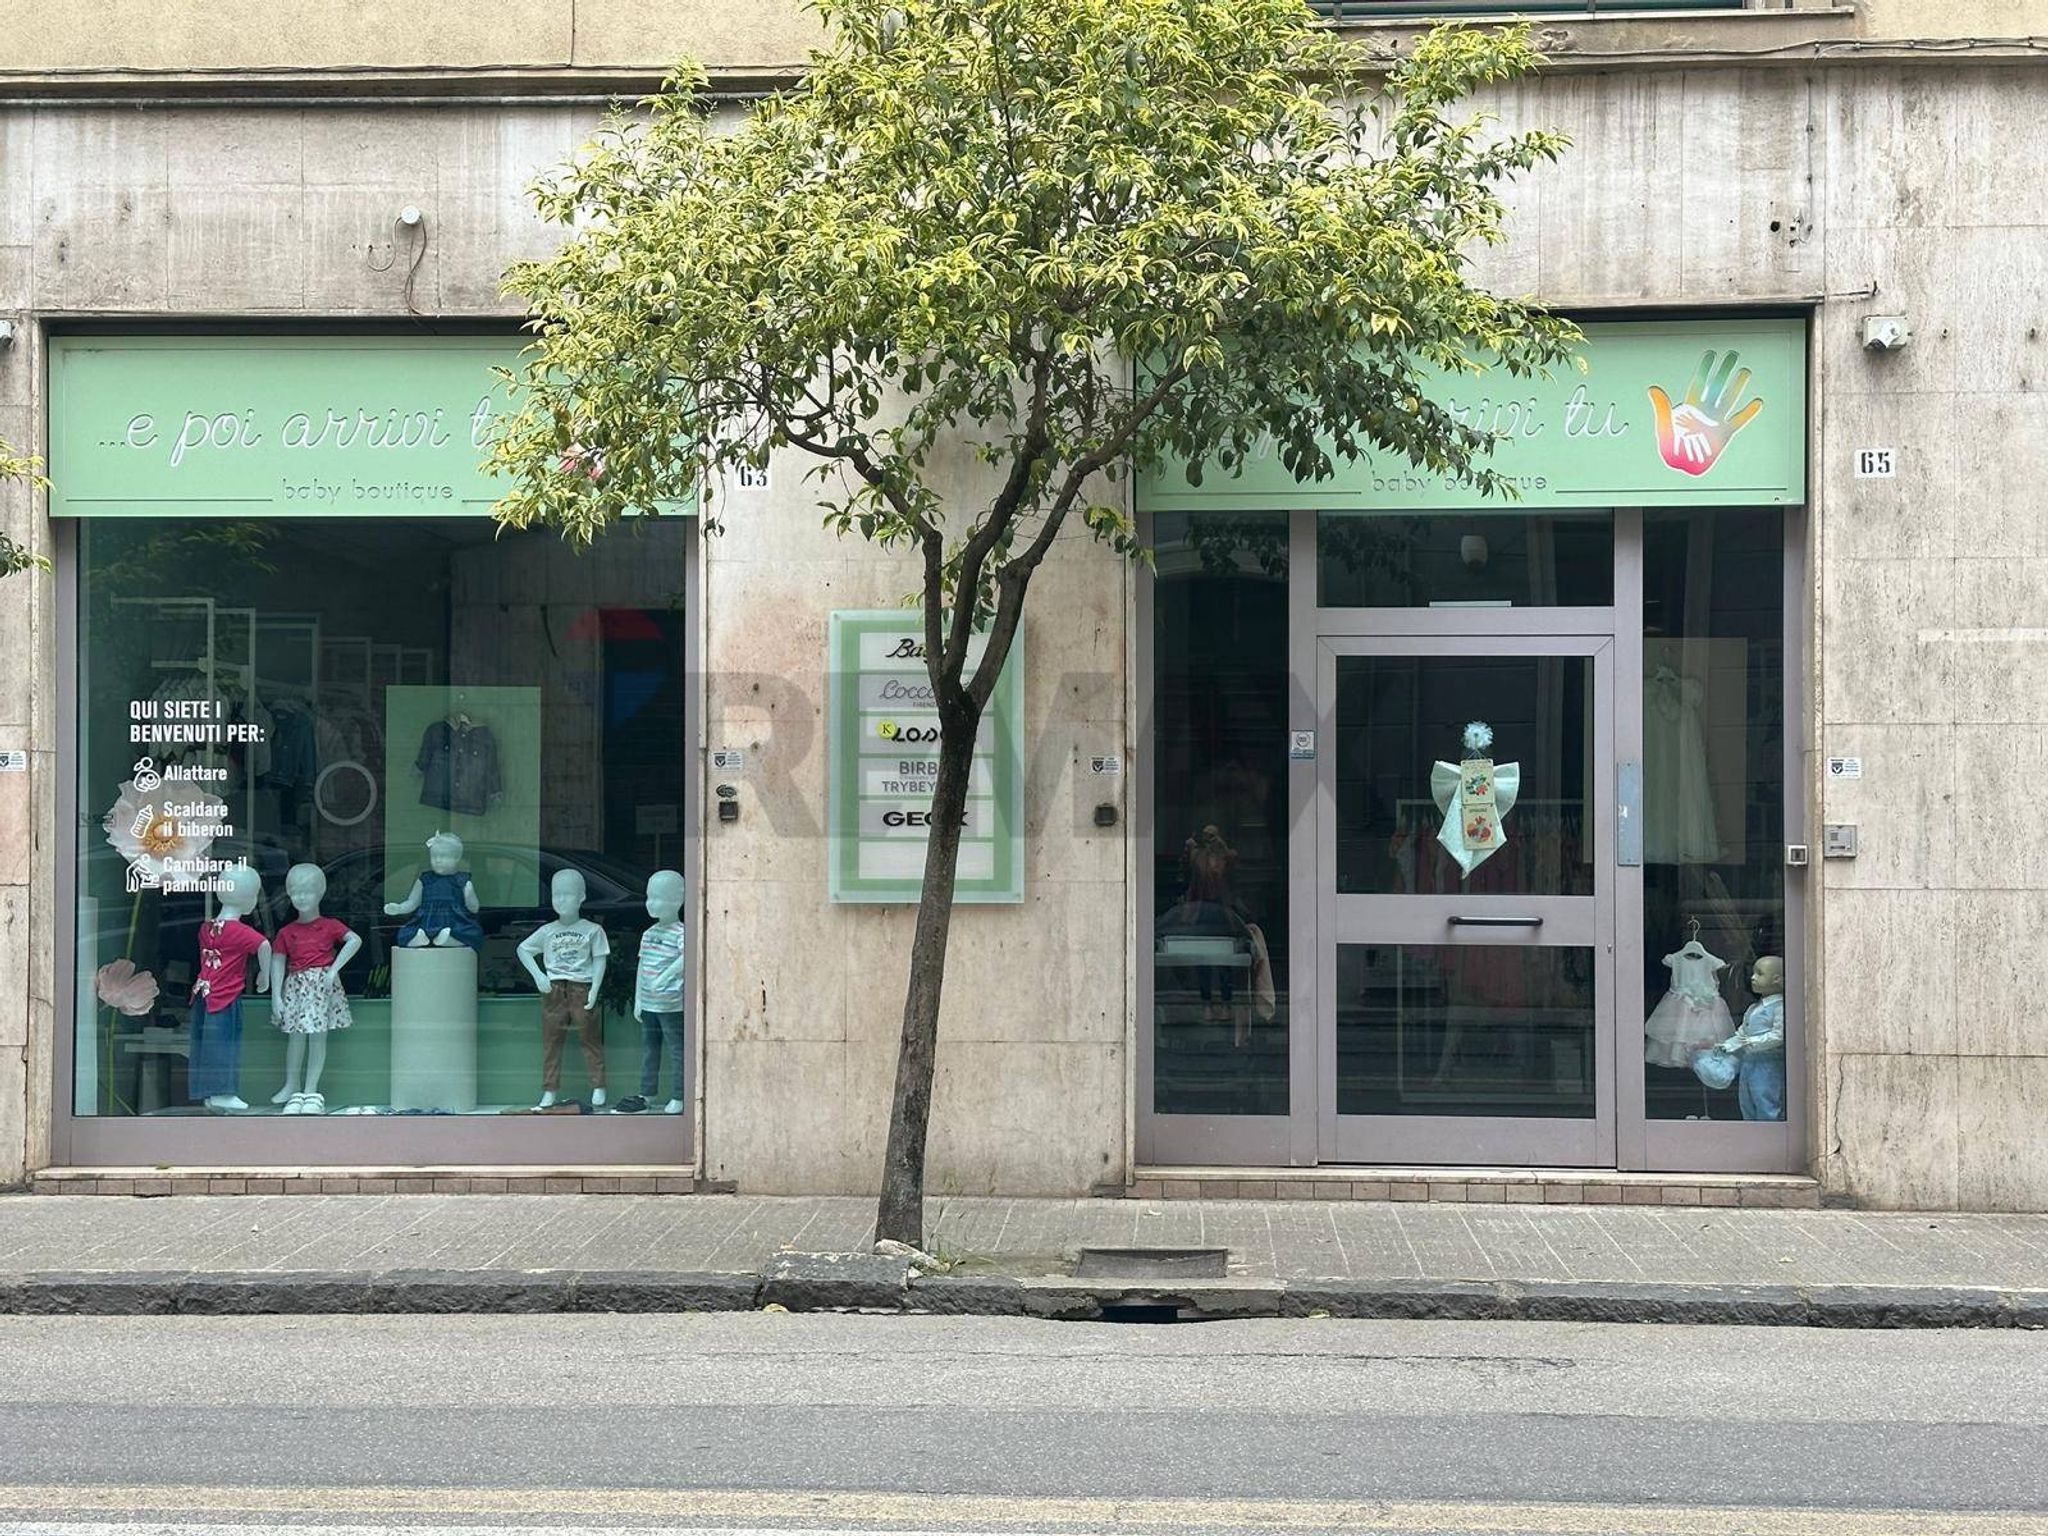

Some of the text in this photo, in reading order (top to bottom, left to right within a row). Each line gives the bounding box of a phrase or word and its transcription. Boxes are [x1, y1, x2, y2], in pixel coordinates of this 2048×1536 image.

[1565, 384, 1630, 438] tu
[170, 408, 262, 467] poi
[281, 407, 450, 449] arrivi
[1861, 452, 1890, 473] 65
[282, 478, 453, 504] baby boutique
[1371, 470, 1431, 496] baby
[130, 700, 221, 720] QUI SIETE I
[130, 724, 265, 742] BENVENUTI PER:
[164, 765, 228, 781] Allattare
[899, 761, 938, 775] BIRB
[163, 801, 229, 817] Scaldare
[163, 821, 233, 837] il biberon
[163, 856, 247, 872] Cambiare il
[162, 878, 235, 895] pannolino
